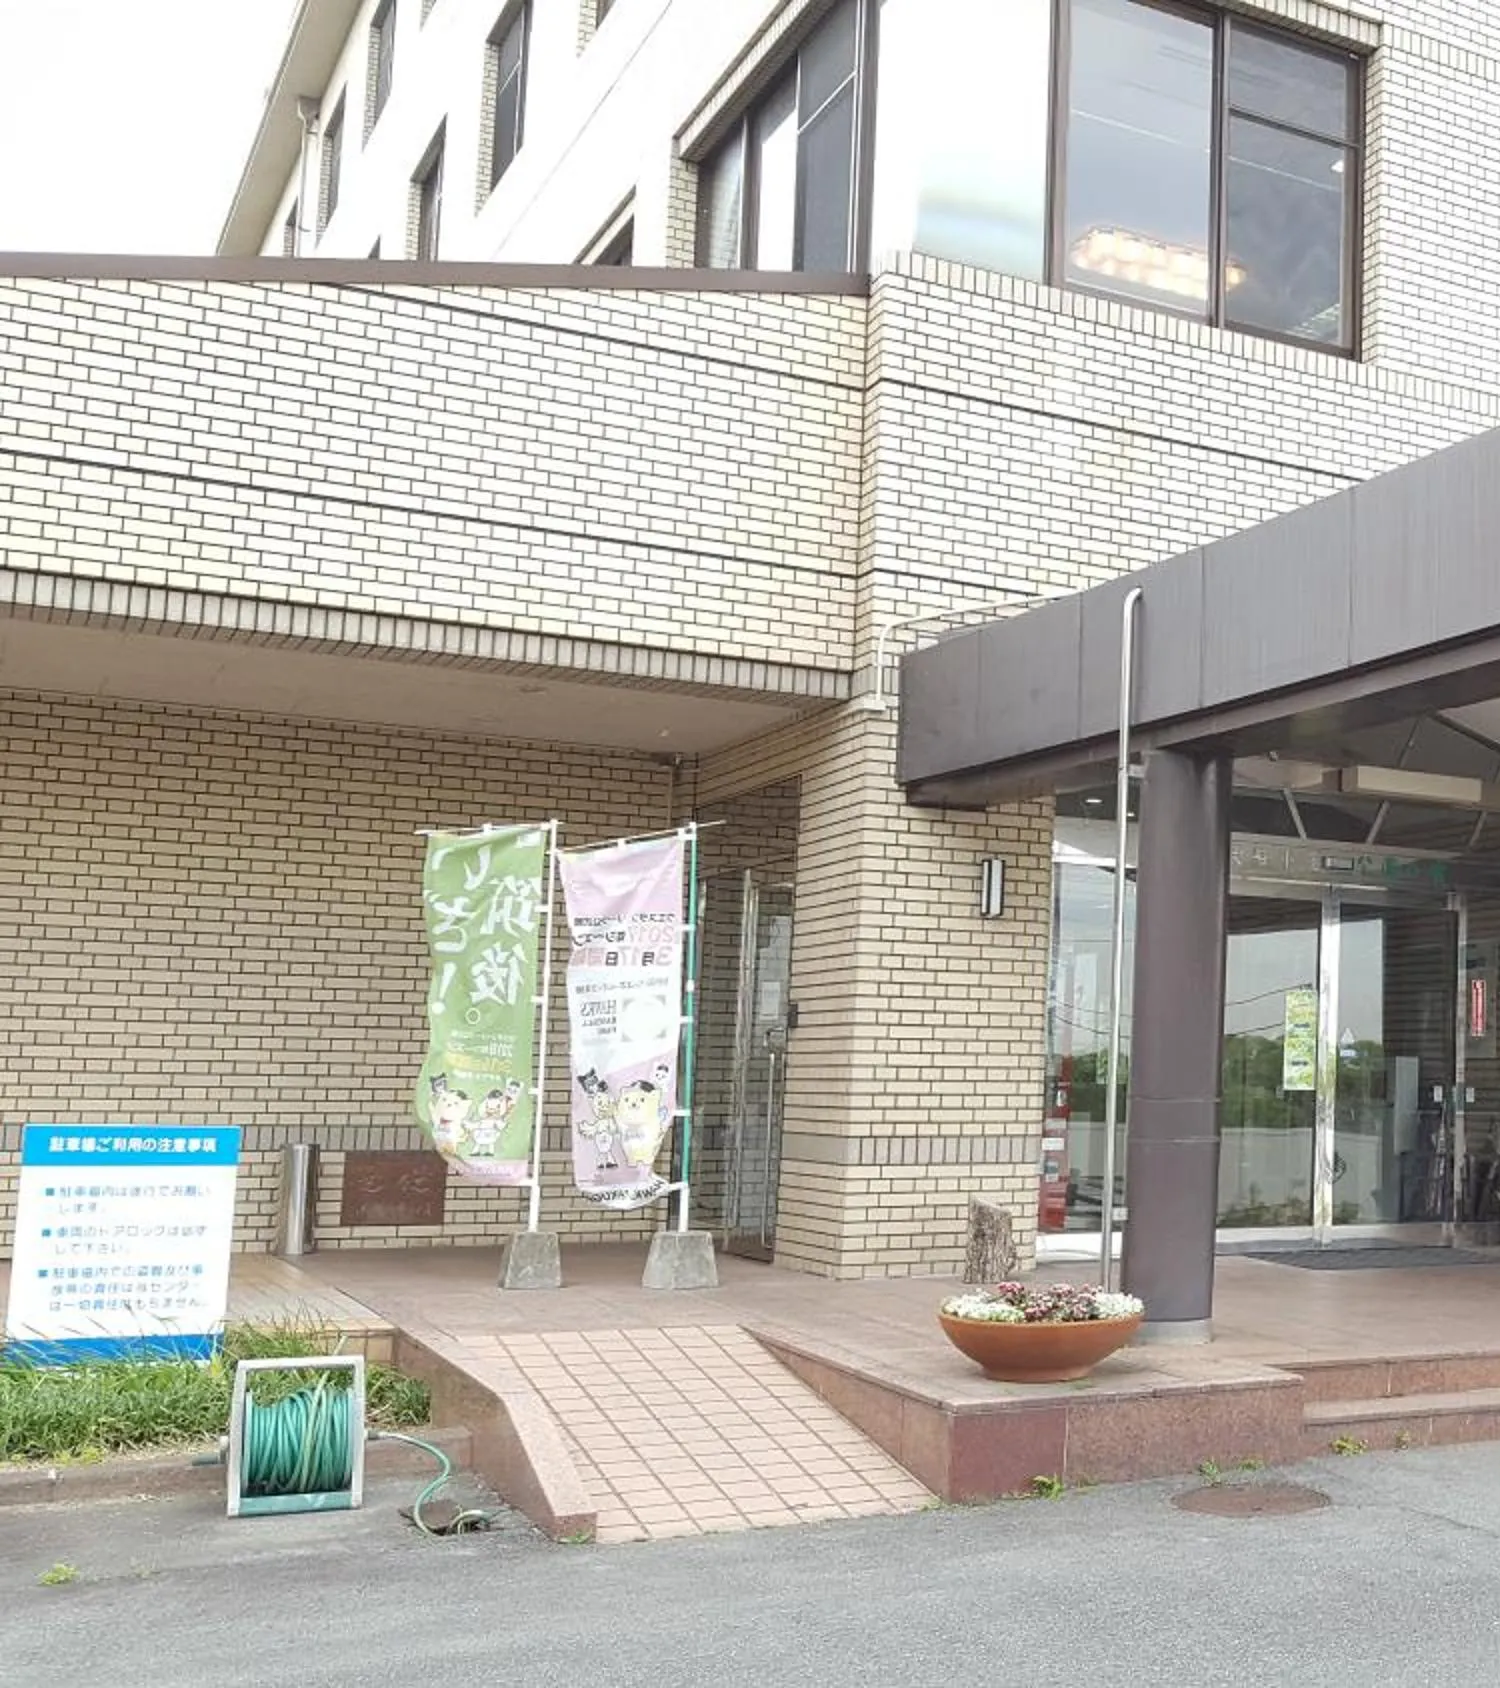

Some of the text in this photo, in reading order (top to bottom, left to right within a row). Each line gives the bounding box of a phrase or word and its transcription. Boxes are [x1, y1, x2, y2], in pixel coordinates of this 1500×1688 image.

[49, 1136, 217, 1153] 駐車場ご利用の注意事項
